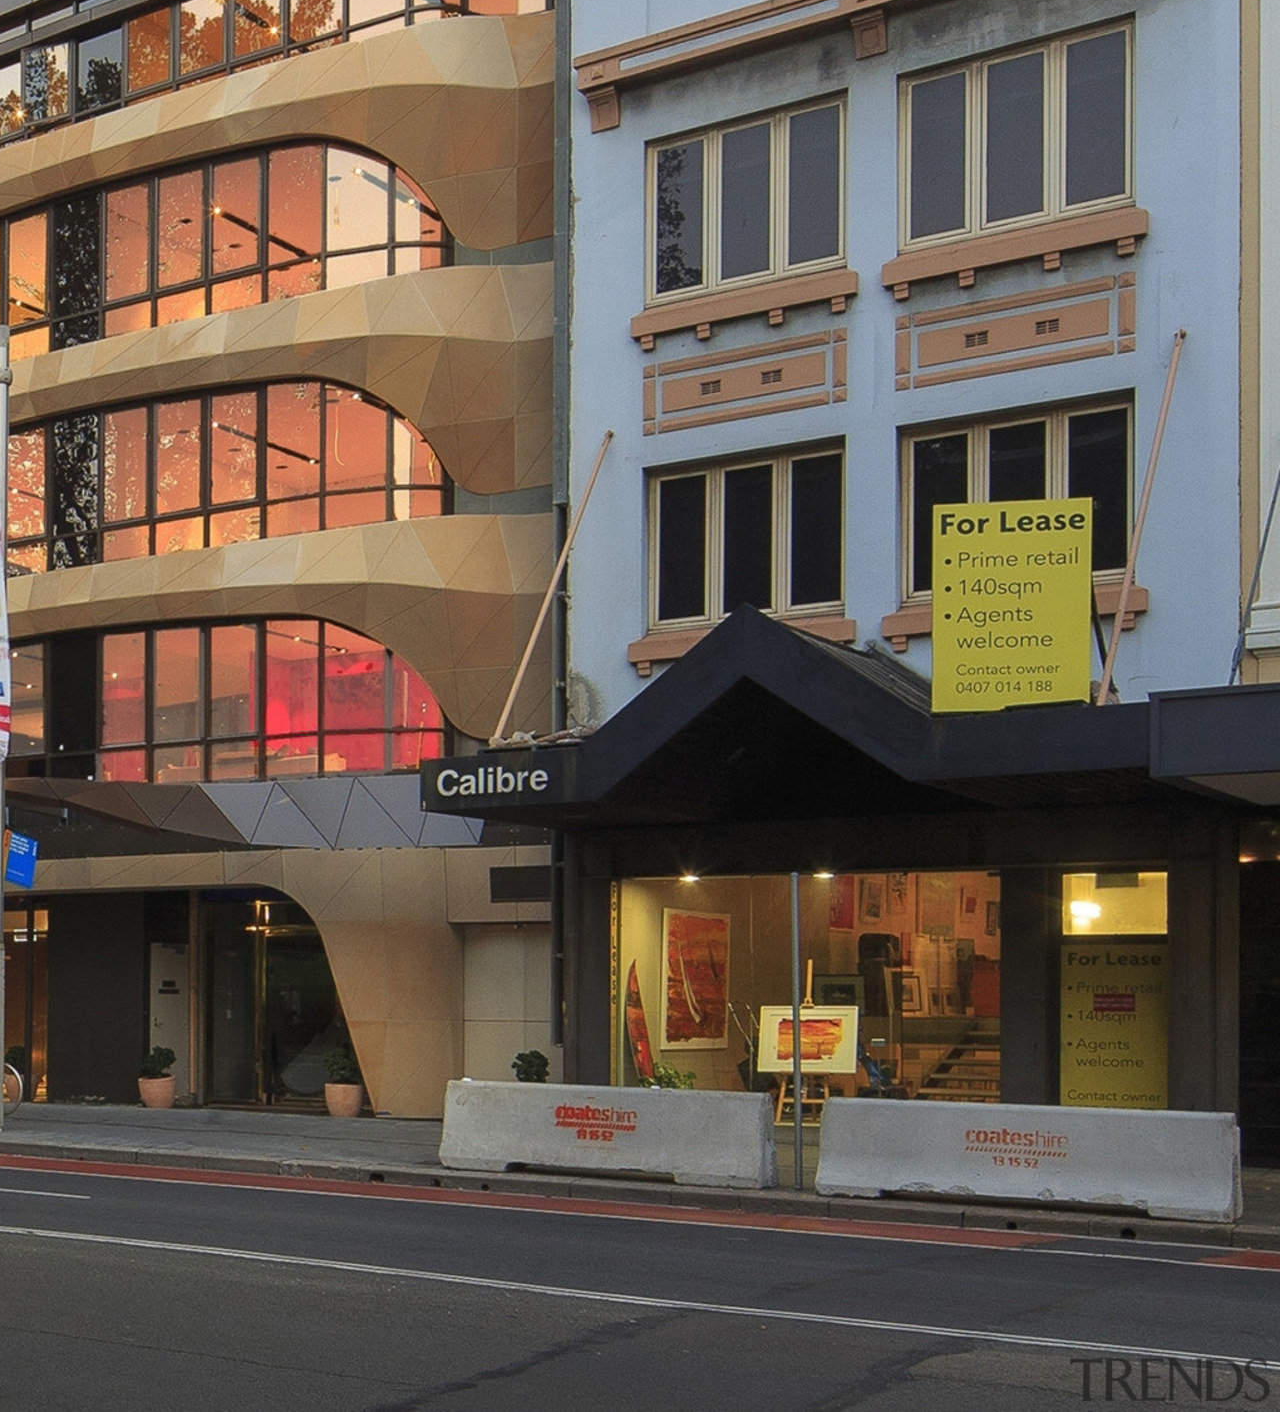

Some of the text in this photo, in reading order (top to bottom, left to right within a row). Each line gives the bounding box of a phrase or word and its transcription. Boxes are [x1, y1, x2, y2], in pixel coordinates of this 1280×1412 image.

[940, 511, 1086, 535] For Lease
[958, 547, 1079, 568] Prime retail
[959, 578, 1042, 599] 140sqm
[956, 607, 1034, 627] Agents
[956, 631, 1053, 650] welcome
[955, 664, 1060, 677] Contact owner
[955, 680, 1053, 694] 0407 014 188
[436, 766, 549, 797] Calibre
[1067, 952, 1162, 967] For Lease
[1076, 981, 1162, 994] Prime retail
[1077, 1009, 1137, 1026] 140sqm
[1075, 1038, 1131, 1053] Agents
[1075, 1055, 1145, 1068] welcome
[1067, 1089, 1161, 1102] Contact owner
[965, 1128, 1069, 1148] coateshire
[992, 1156, 1039, 1169] 13 15 52
